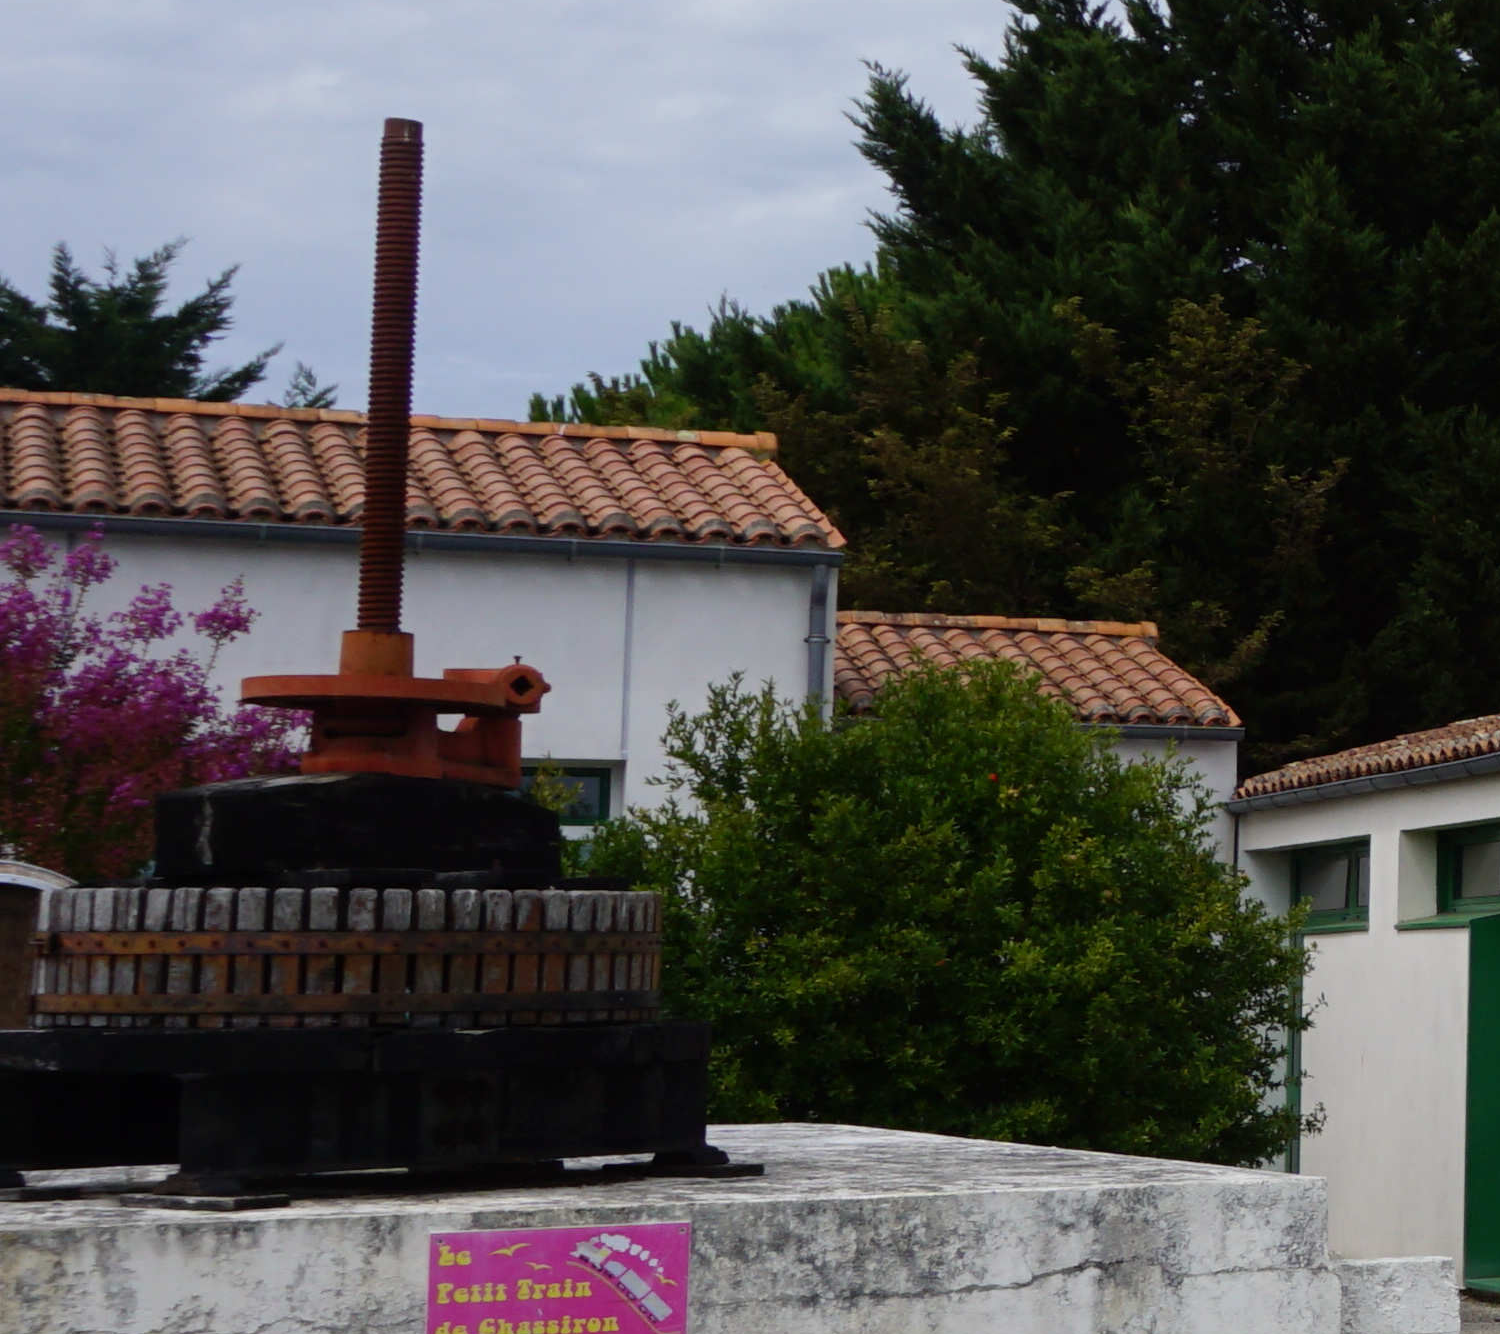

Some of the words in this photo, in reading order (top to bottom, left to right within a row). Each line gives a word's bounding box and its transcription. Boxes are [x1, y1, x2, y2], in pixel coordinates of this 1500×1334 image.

[438, 1245, 472, 1267] Le
[436, 1282, 508, 1304] Petit
[516, 1279, 592, 1300] Train
